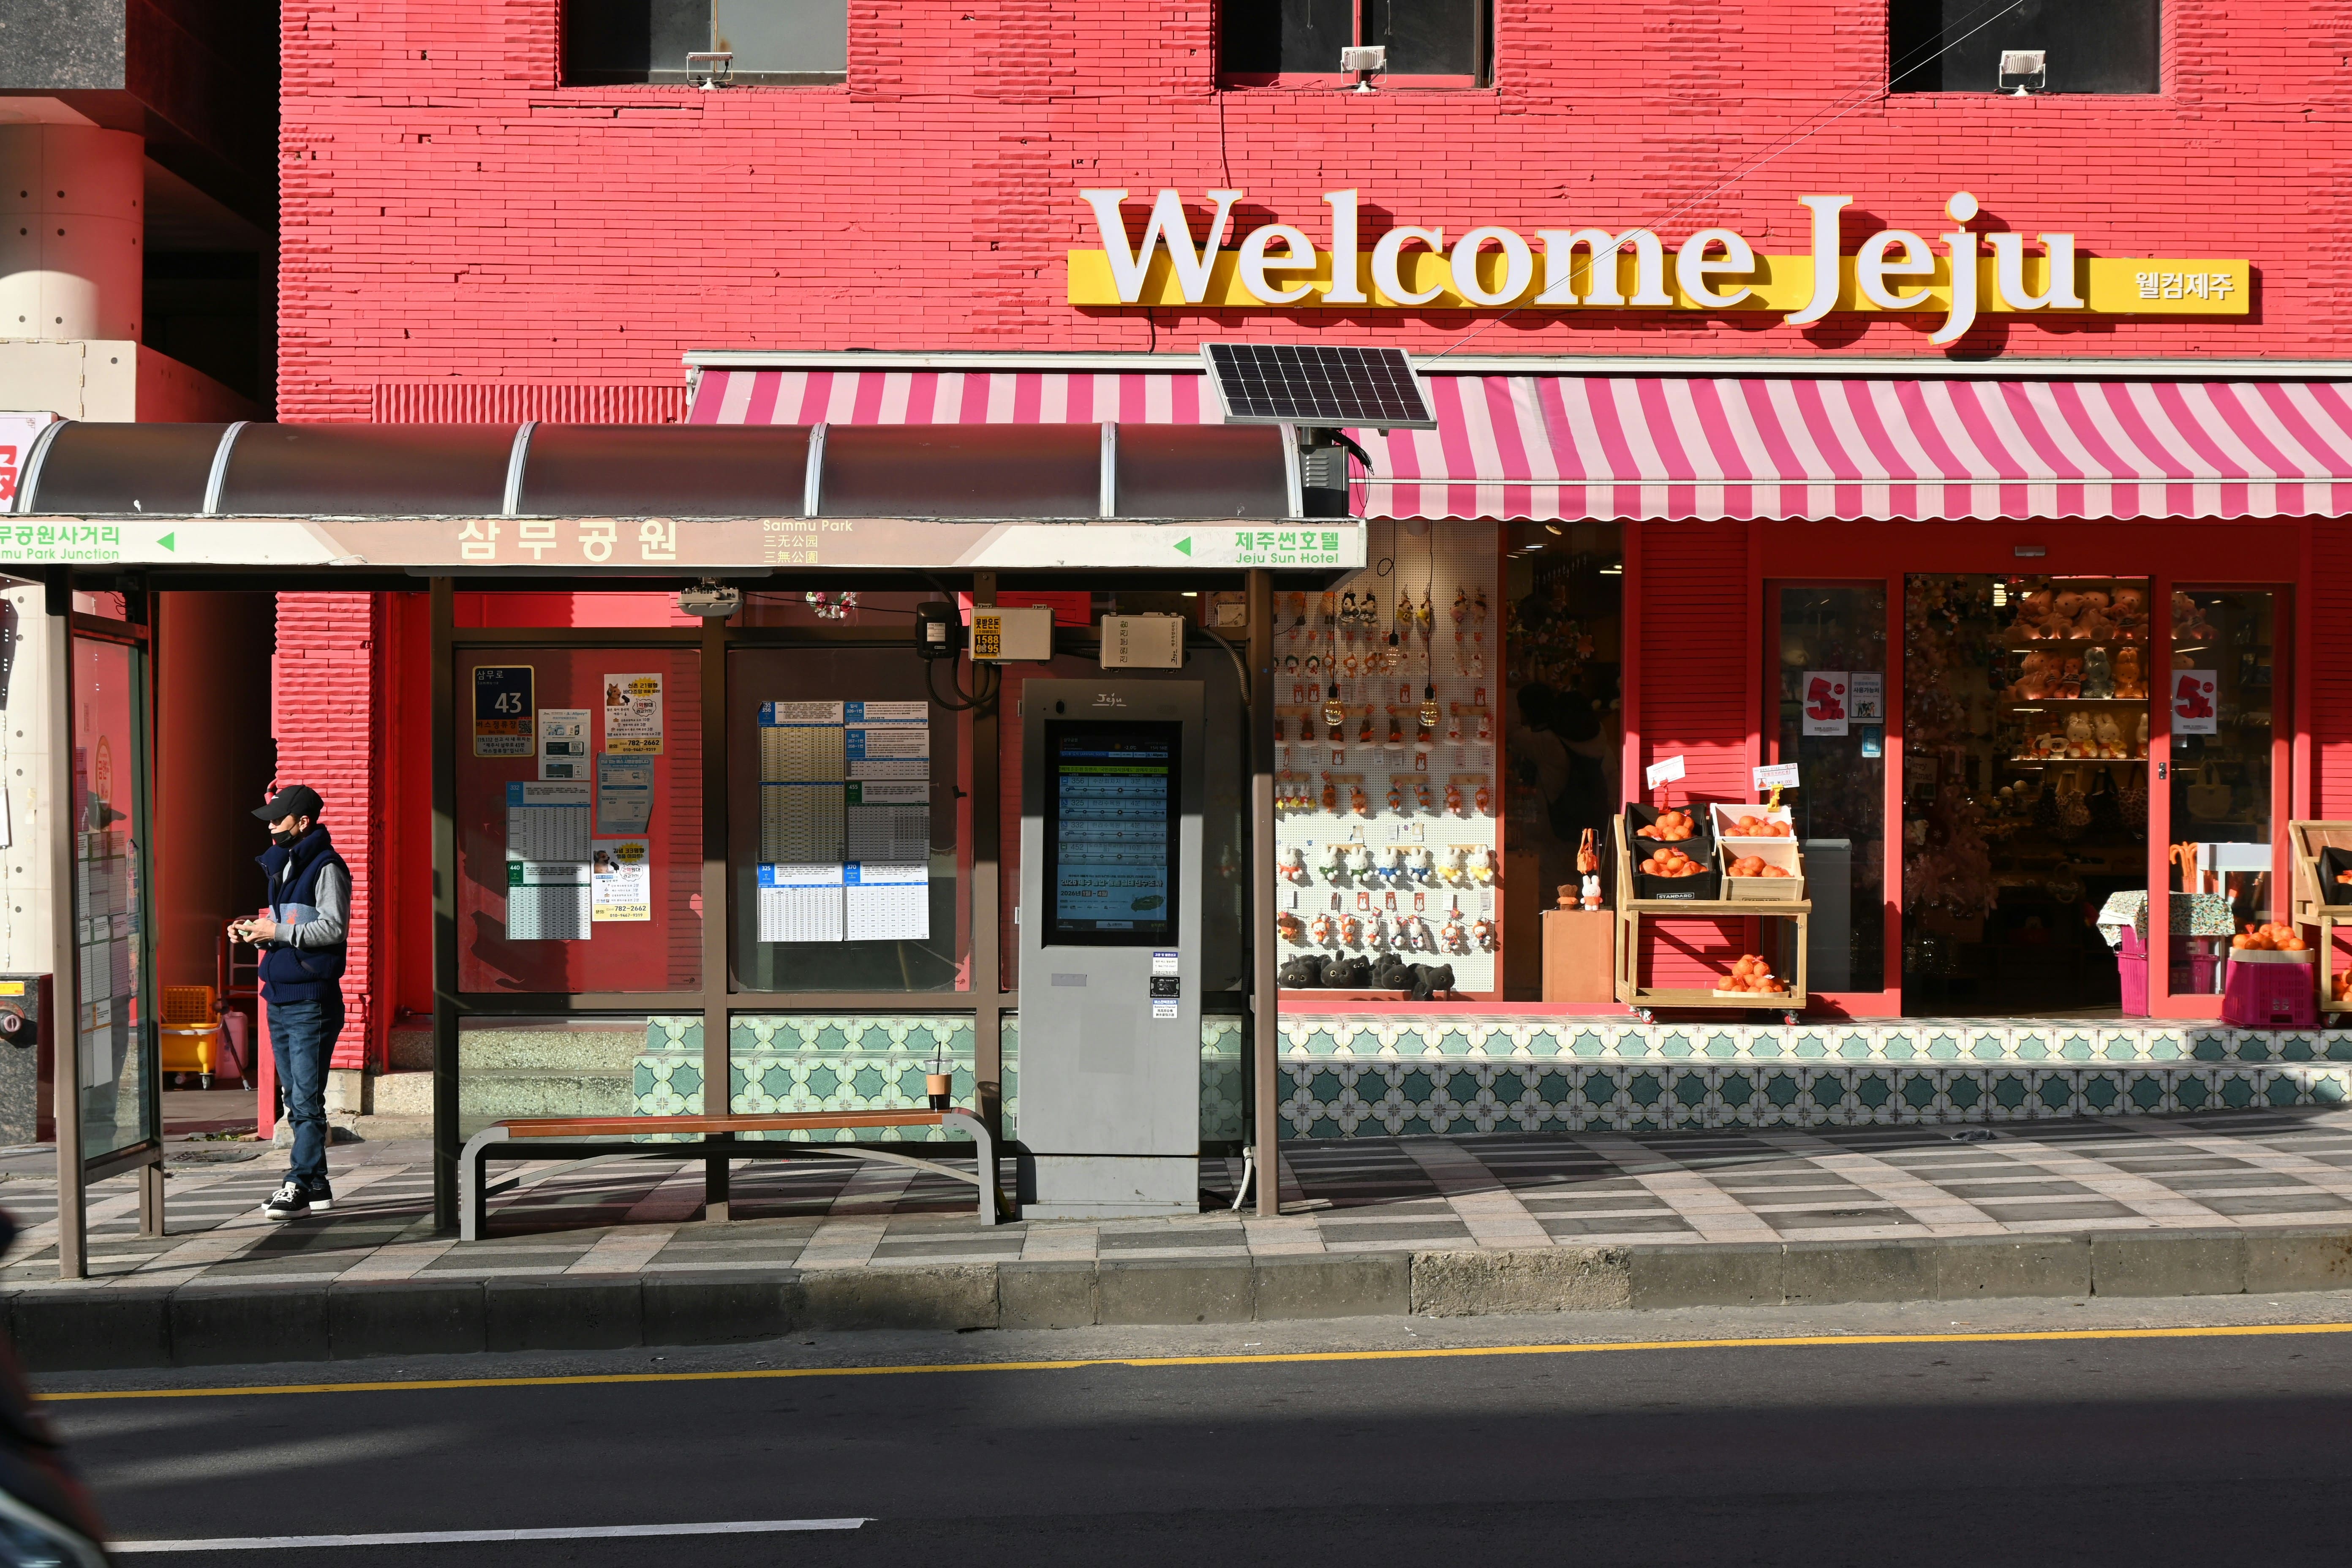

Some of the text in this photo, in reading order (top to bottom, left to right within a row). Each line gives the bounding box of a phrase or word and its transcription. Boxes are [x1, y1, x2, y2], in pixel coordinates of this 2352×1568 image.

[1078, 188, 2085, 346] Welcome Jeju
[2135, 272, 2234, 300] 웰컴제주
[763, 520, 853, 532] Sammu Park
[459, 520, 676, 562] 삼무공원
[763, 535, 818, 548] 三无公园
[1235, 531, 1339, 551] 제주썬호텔
[27, 548, 56, 559] Park
[61, 548, 119, 559] Junction
[763, 550, 818, 564] 三無公園
[1235, 553, 1339, 565] Jeju Sun Hotel
[976, 618, 999, 629] 못받은돈
[976, 635, 999, 644] 1588
[1119, 621, 1128, 663] 전원분전함
[476, 670, 504, 681] 삼무로
[494, 692, 522, 713] 43
[1096, 692, 1123, 707] Jeju
[476, 721, 517, 729] 버스정류장
[1912, 763, 1927, 771] erry
[1061, 879, 1078, 887] 2026
